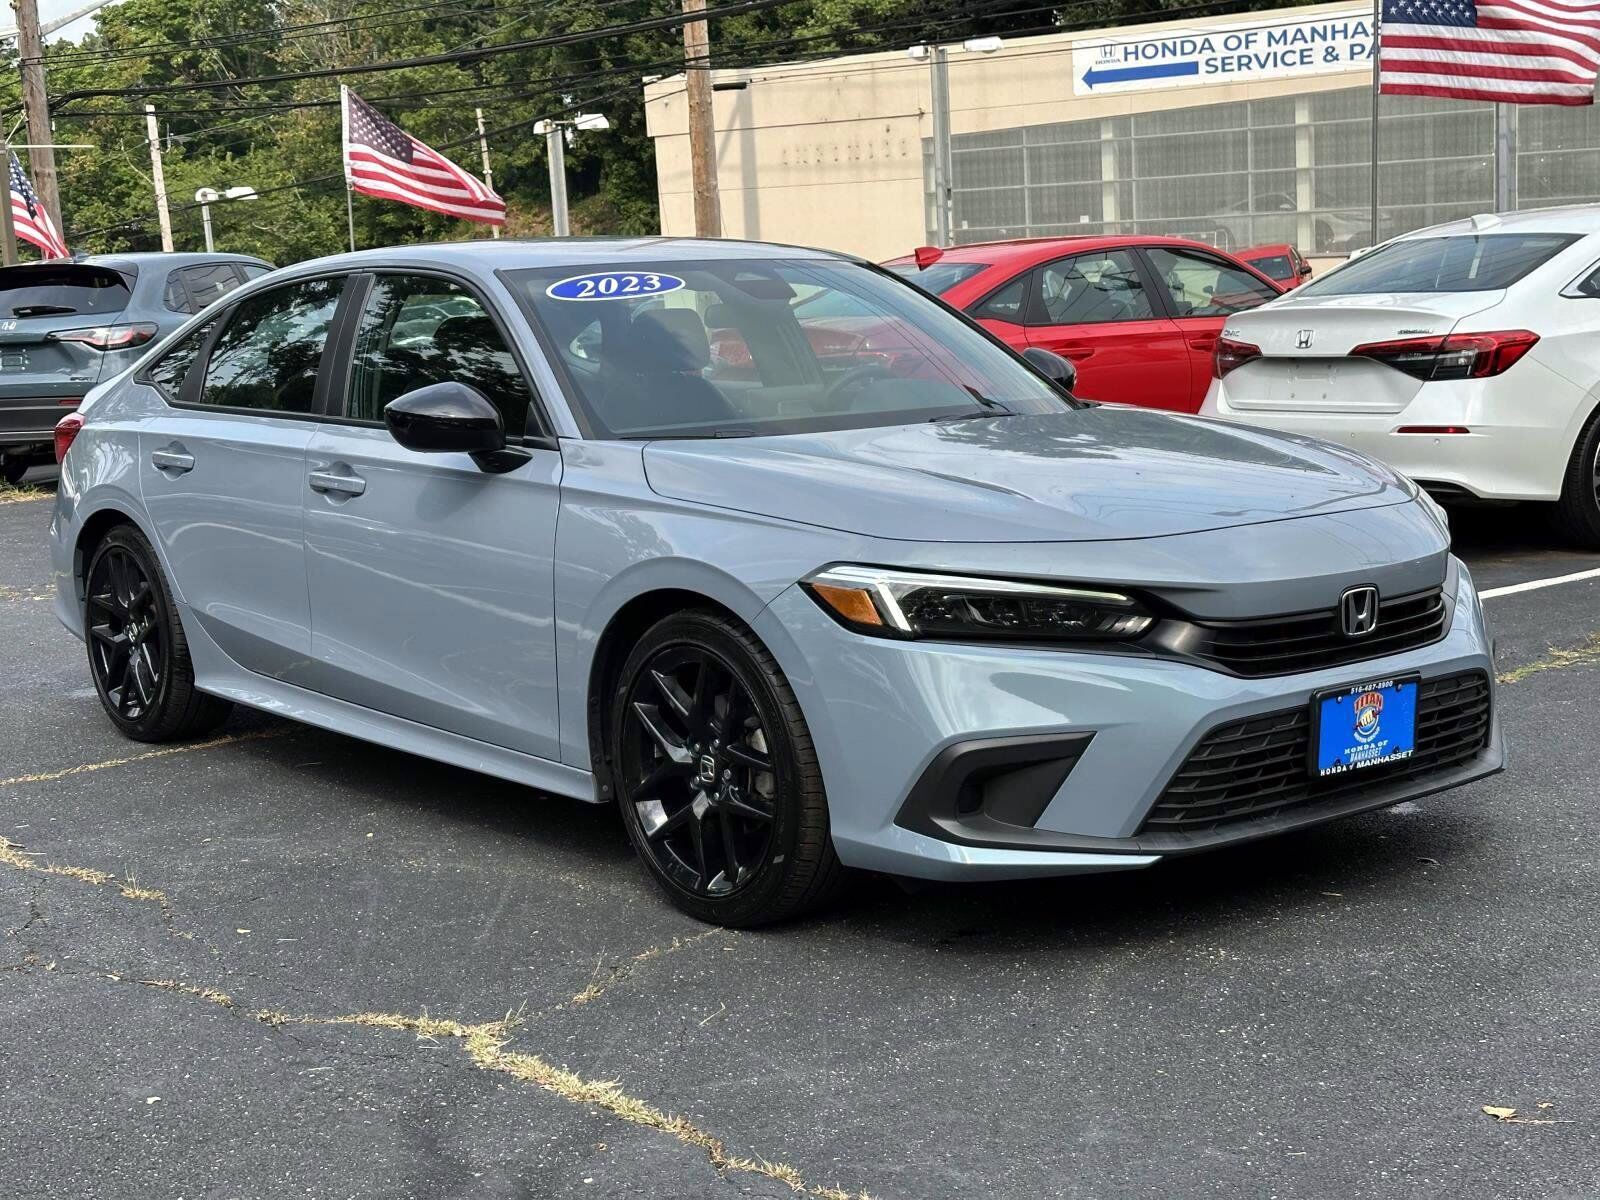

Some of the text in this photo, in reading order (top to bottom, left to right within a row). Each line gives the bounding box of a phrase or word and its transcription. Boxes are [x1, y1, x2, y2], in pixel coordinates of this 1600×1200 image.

[1123, 37, 1216, 62] HONDA
[1223, 32, 1258, 51] OF
[1204, 47, 1314, 74] SERVICE
[1322, 45, 1339, 63] &
[576, 275, 661, 298] 2023
[1354, 692, 1383, 713] TITAN
[1344, 742, 1376, 755] HONDA
[1320, 765, 1346, 776] HONDA
[1356, 749, 1414, 769] MANHASSET
